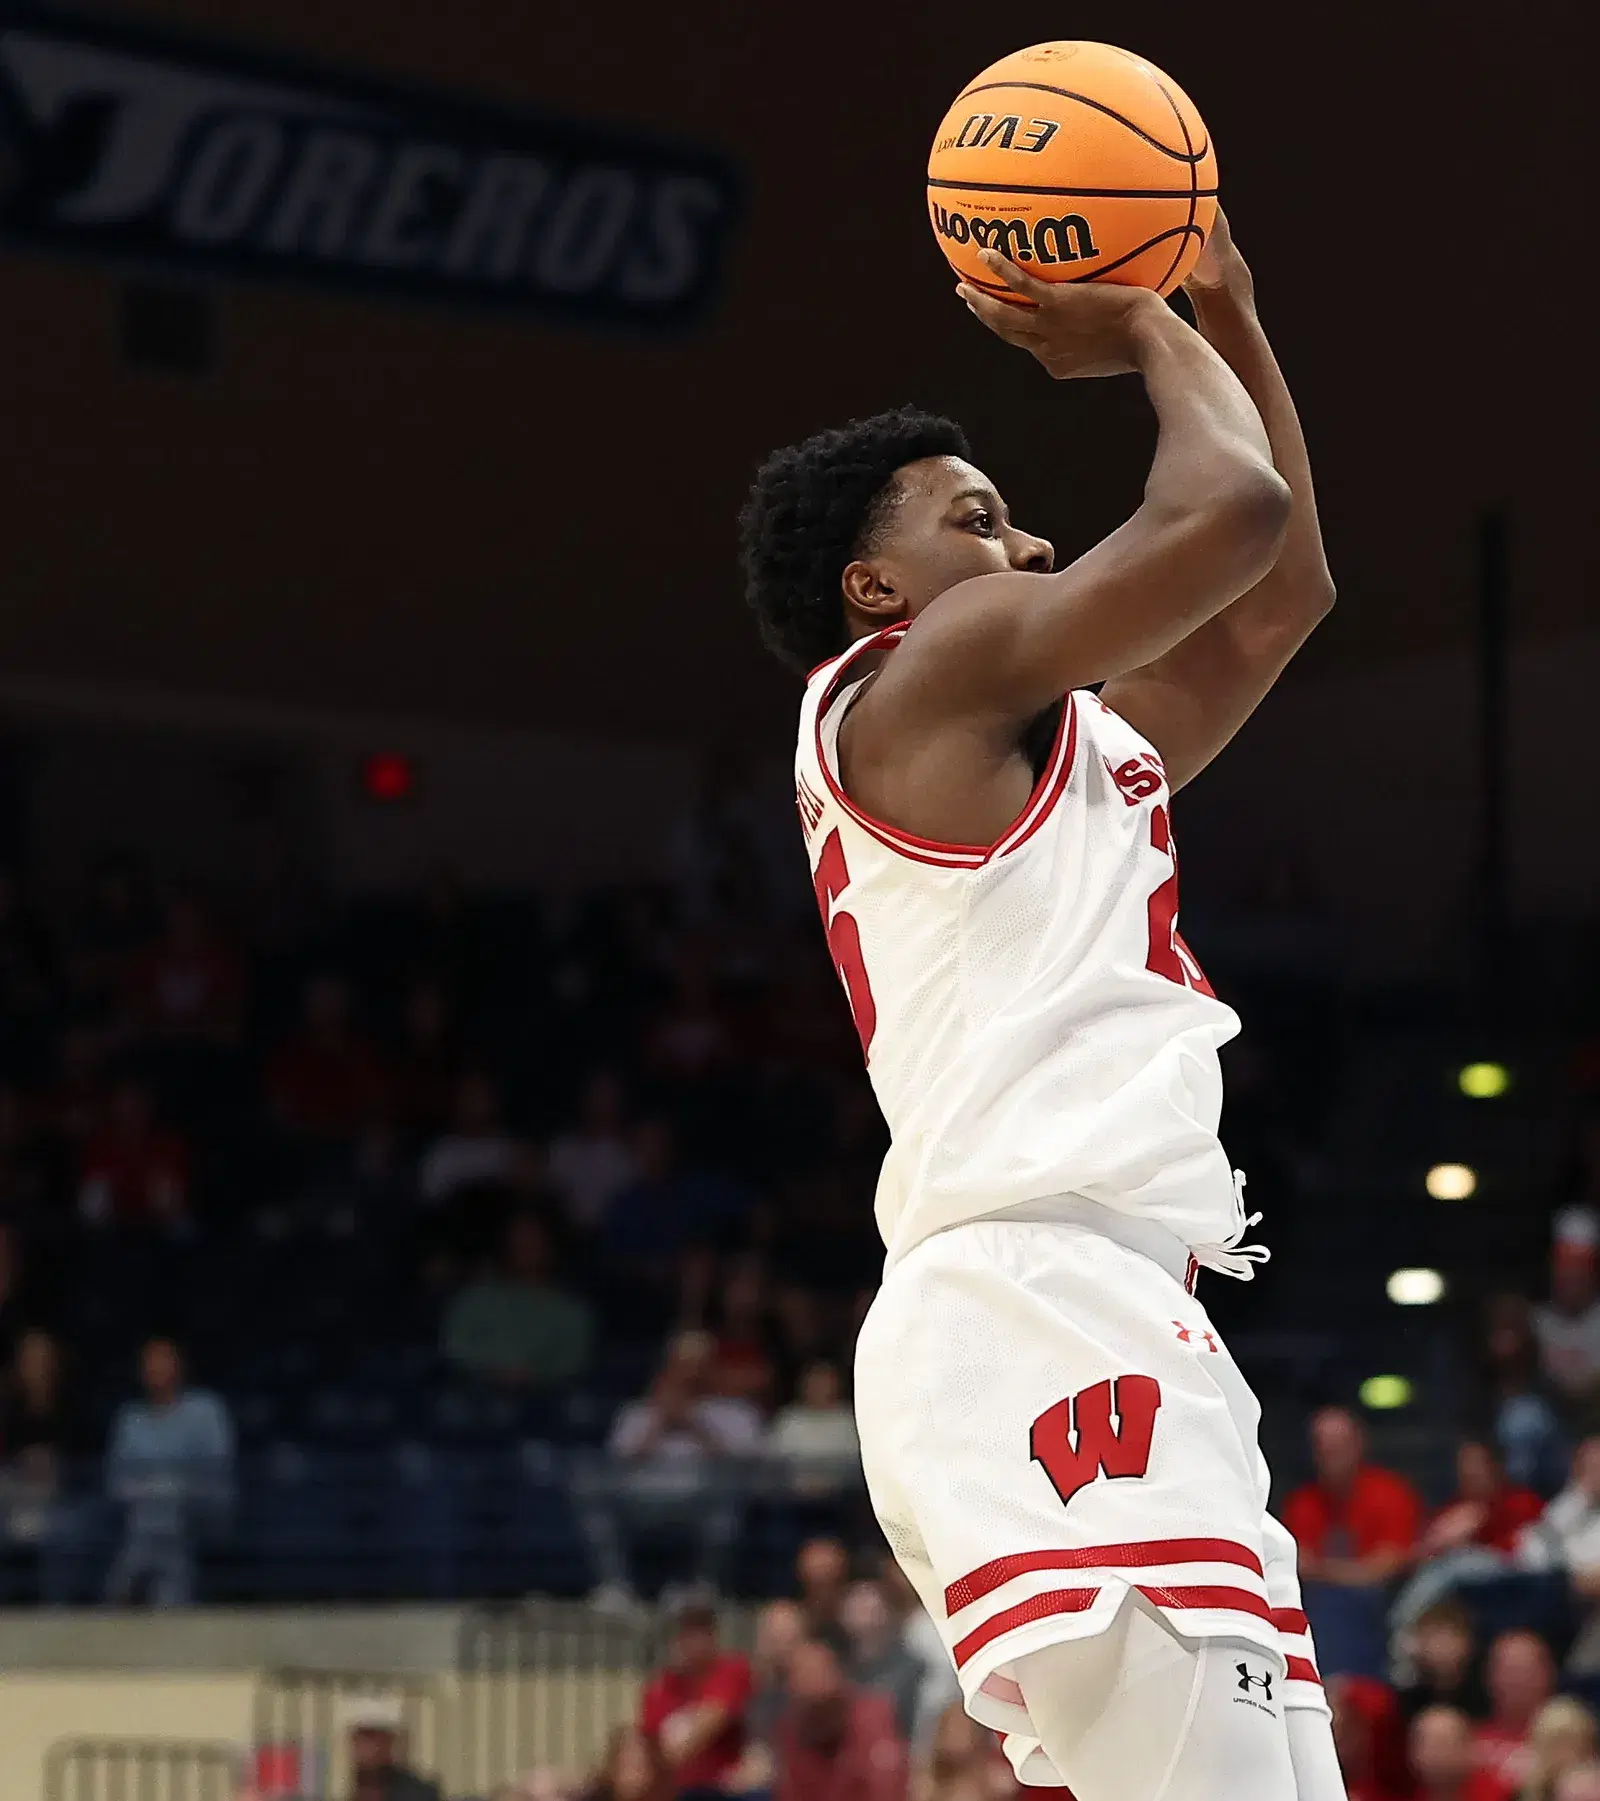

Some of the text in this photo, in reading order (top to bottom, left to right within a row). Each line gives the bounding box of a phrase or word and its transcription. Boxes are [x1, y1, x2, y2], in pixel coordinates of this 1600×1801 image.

[1, 30, 722, 304] TOREROS
[955, 115, 1059, 152] EVO
[932, 201, 1100, 264] Wilson
[1029, 1374, 1162, 1507] W
